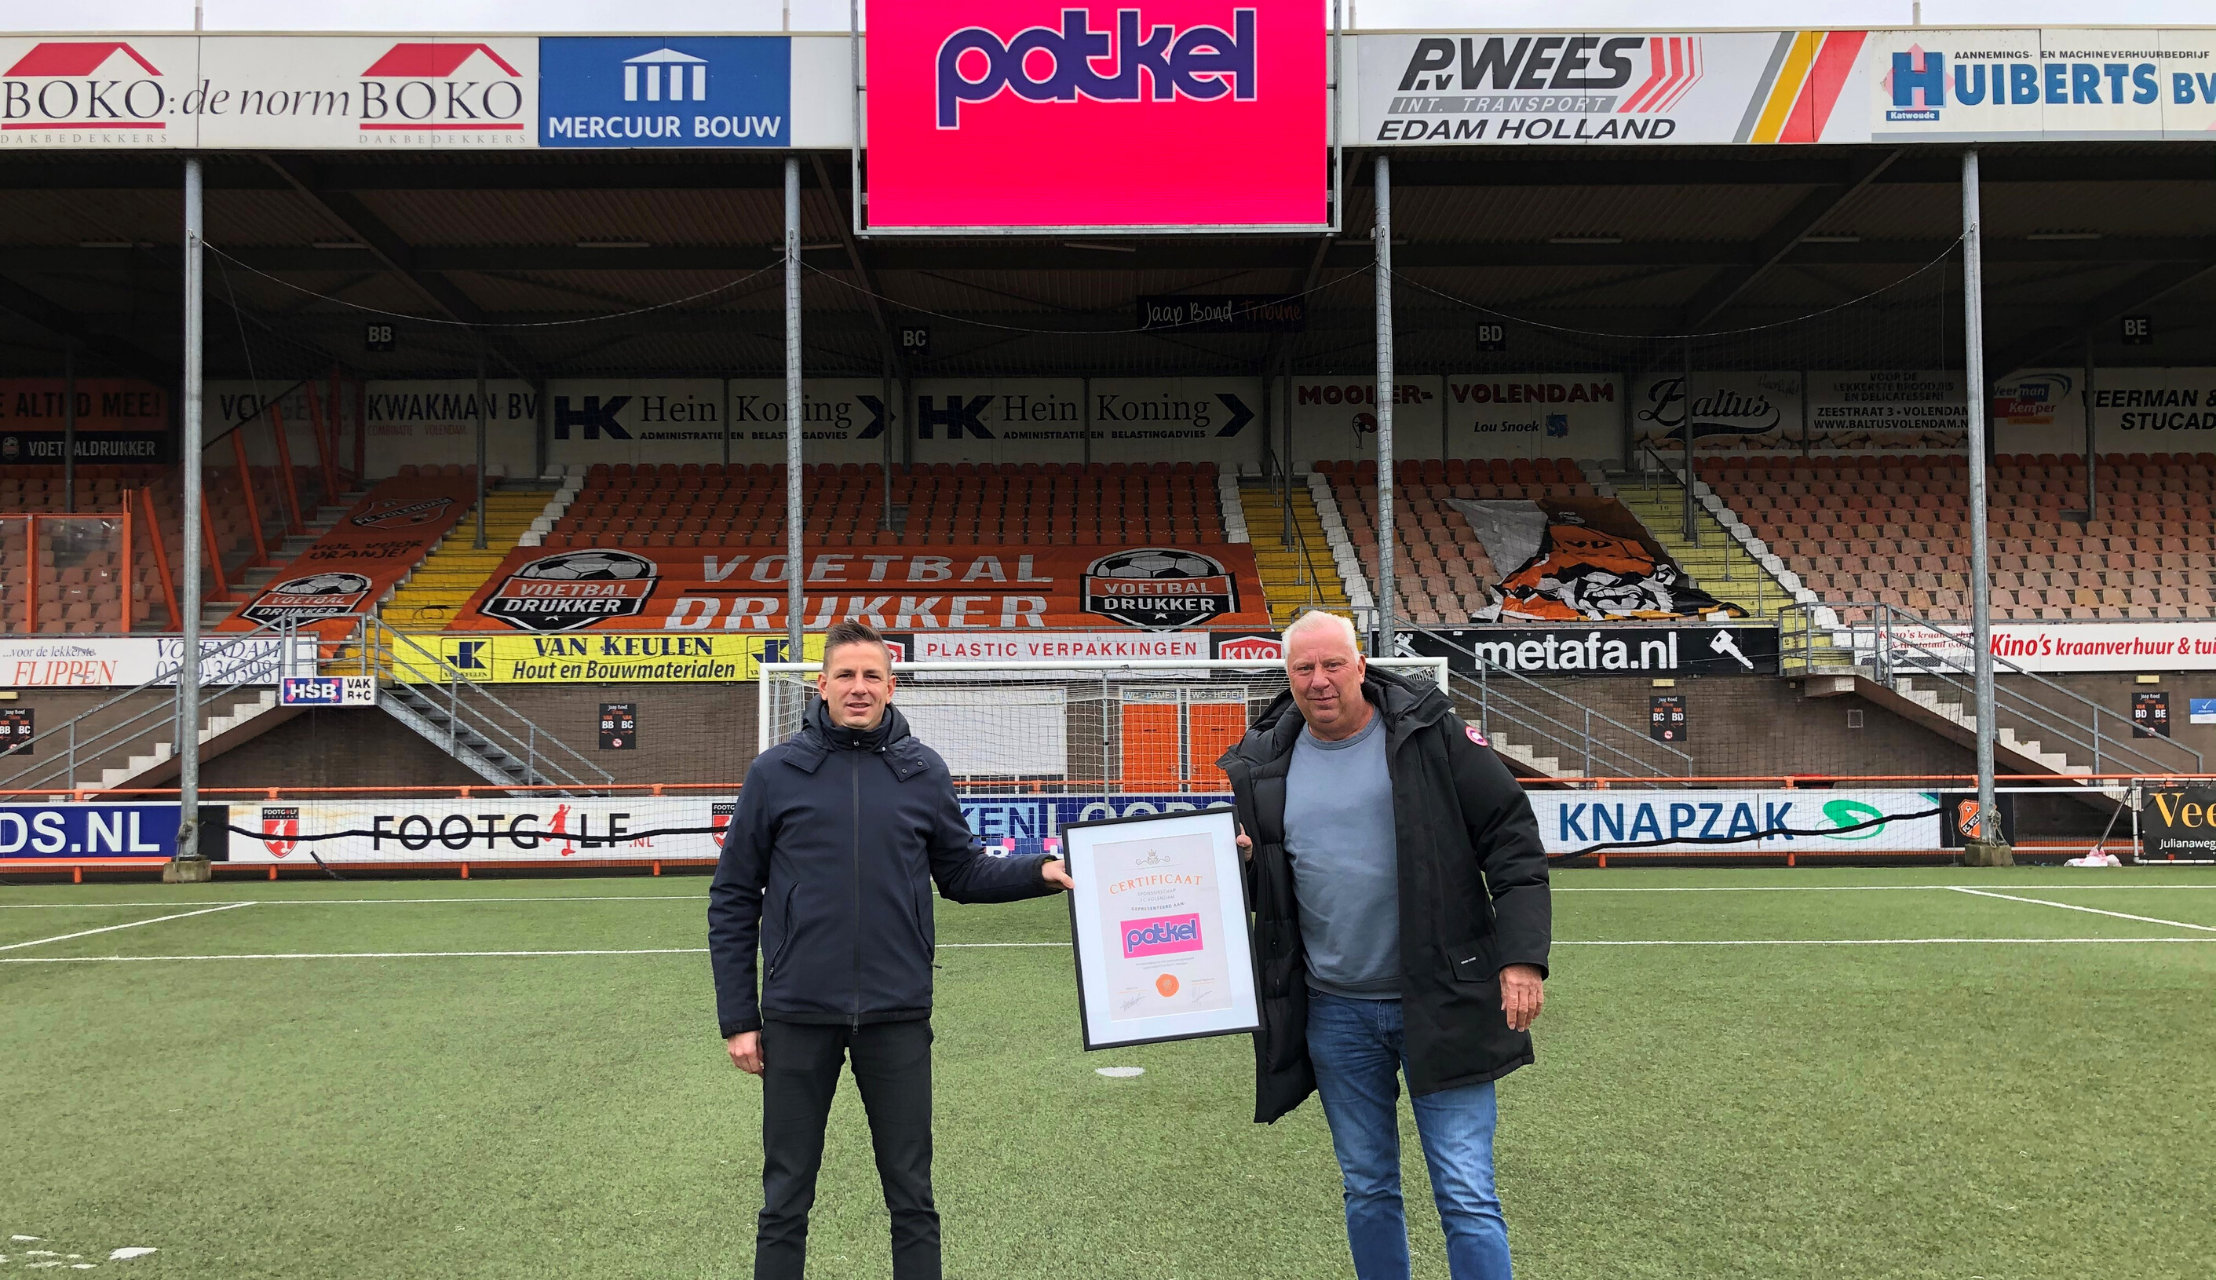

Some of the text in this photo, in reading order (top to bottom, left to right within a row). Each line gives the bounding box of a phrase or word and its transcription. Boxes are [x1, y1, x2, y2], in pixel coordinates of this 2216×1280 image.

[1954, 50, 2211, 60] AANNEMINGS- EN MACHINEVERHUURBEDRIJF
[936, 7, 1257, 130] patkel
[1892, 51, 2216, 107] HUIBERTS BV
[182, 79, 229, 116] de
[240, 87, 350, 117] norm
[359, 80, 524, 120] BOKO
[1397, 96, 1607, 113] INT. TRANSPORT
[1890, 111, 1936, 121] Katwoude
[548, 115, 781, 139] MERCUUR BOUW
[1376, 118, 1677, 140] EDAM HOLLAND
[0, 133, 168, 144] DAKBEDEKKERS
[359, 134, 526, 145] DAKBEDEKKERS
[1142, 300, 1302, 329] Jaap Bond Tribune
[368, 326, 392, 343] BB
[1479, 325, 1503, 342] BD
[2124, 319, 2147, 336] BE
[903, 330, 927, 347] BC
[1450, 382, 1615, 404] VOLENDAM
[15, 392, 91, 418] ALTID
[102, 392, 160, 418] MEE!
[368, 393, 497, 421] KWAKMAN
[508, 393, 538, 420] BV
[641, 395, 852, 429] Hein Koing
[1003, 393, 1211, 427] Hein Koning
[1817, 407, 1885, 417] ZEESTRAAT
[1887, 407, 1894, 417] 3
[2009, 402, 2057, 414] Kemper
[555, 395, 633, 440] HK
[918, 395, 996, 440] HK
[1814, 419, 1968, 429] WWW.BALTUSVOLENDAM.N
[424, 425, 467, 435] VOLENDAM
[1003, 430, 1206, 439] ADMINISTRATIE EN BELASTINGADVIES
[1474, 420, 1540, 433] Lou Snoek
[640, 432, 848, 440] ADMINISTRATIE EN BELASTGADVIES
[28, 441, 156, 457] VOETALDRUKKER
[704, 554, 1054, 584] VOETBAL
[520, 583, 629, 598] VOETBAL
[1104, 582, 1210, 595] VOETBAL
[502, 598, 622, 614] DRUKKER
[664, 595, 1049, 631] DRUKKER
[1103, 597, 1216, 612] DRUKKER
[36, 646, 48, 657] de
[157, 639, 281, 659] VOENDAM
[534, 636, 714, 656] VAN KEULEN
[927, 641, 1198, 657] PLASTIC VERPAKKINGEN
[1225, 646, 1278, 660] KIVO
[1474, 631, 1679, 671] metafa.nl
[1990, 634, 2052, 656] Kino's
[2056, 637, 2175, 656] kraanverhuur
[2178, 637, 2191, 655] &
[12, 660, 118, 686] FLIPPEN
[513, 660, 735, 680] Hout en Bouwmaterialen
[290, 683, 337, 699] HSB
[347, 678, 371, 688] VAK
[1147, 691, 1176, 699] DAMES
[1214, 691, 1243, 699] HEREN
[1653, 712, 1665, 721] BC
[1671, 712, 1684, 721] BD
[2135, 709, 2147, 718] BD
[2155, 709, 2166, 718] BE
[18, 725, 31, 735] BC
[602, 720, 614, 729] BB
[621, 720, 634, 729] BC
[1559, 802, 1795, 841] KNAPZAK
[0, 810, 160, 854] DS.NL
[1109, 873, 1203, 895] CERTIFICAAT
[1127, 919, 1198, 953] patkel
